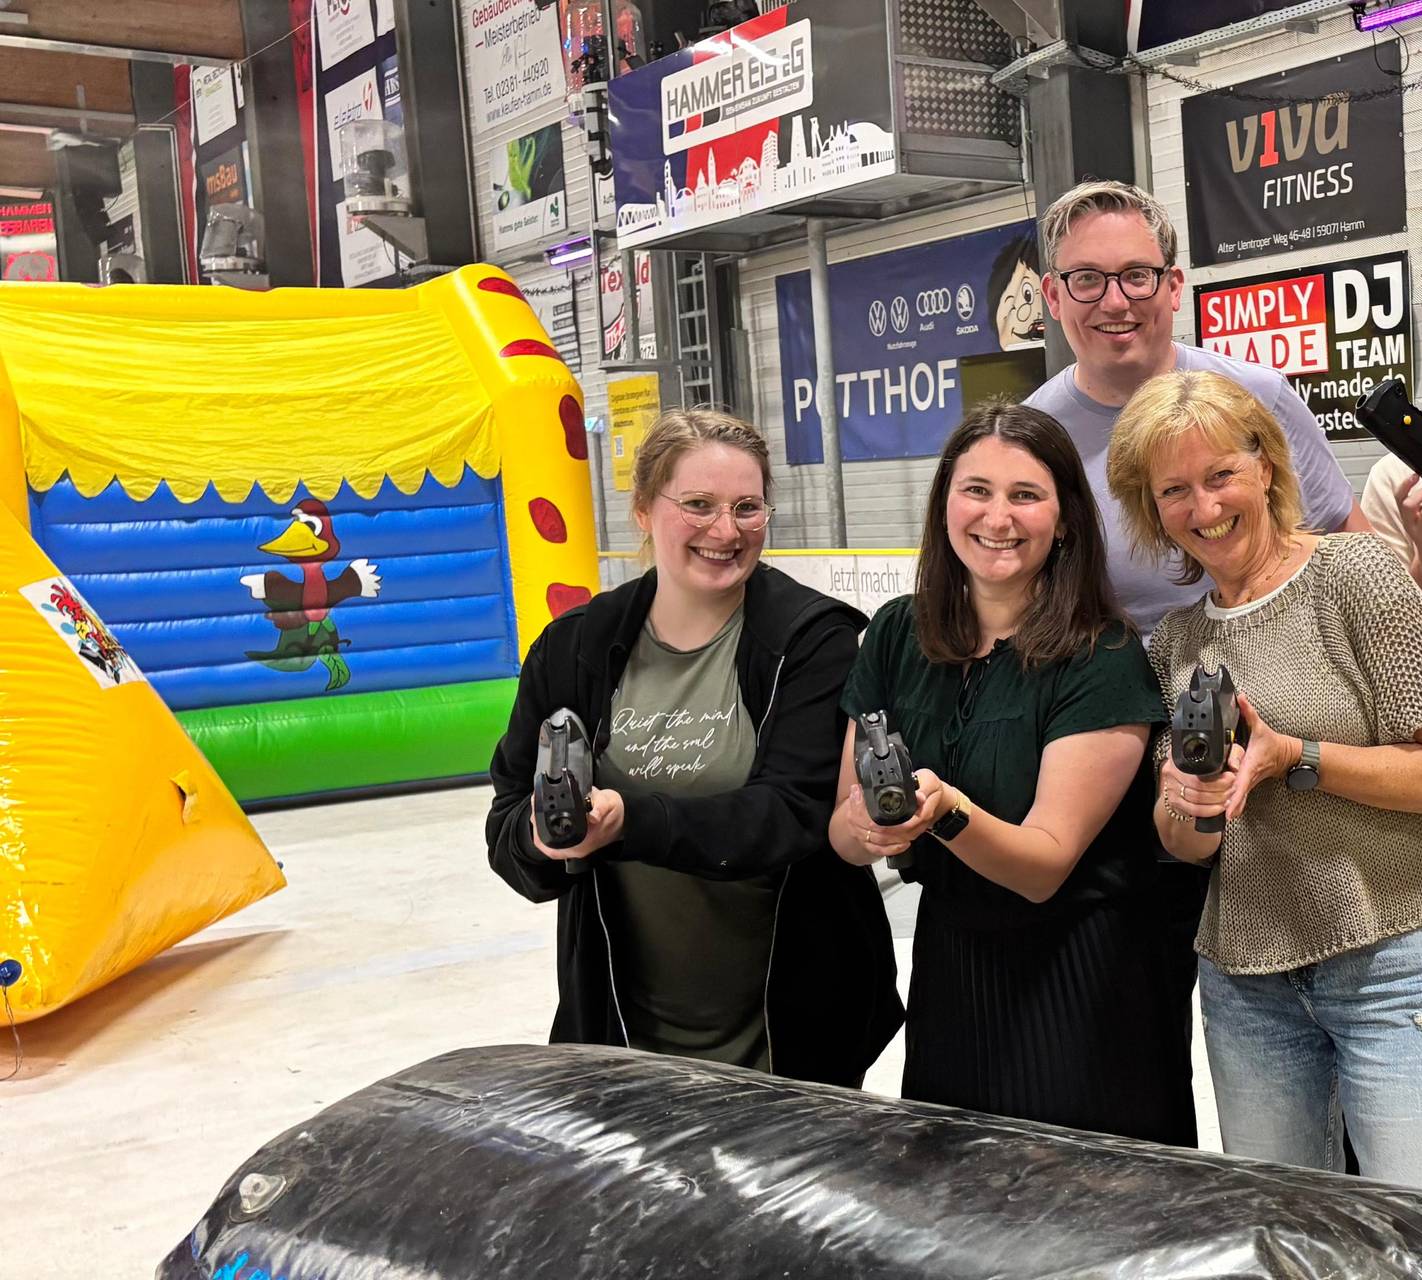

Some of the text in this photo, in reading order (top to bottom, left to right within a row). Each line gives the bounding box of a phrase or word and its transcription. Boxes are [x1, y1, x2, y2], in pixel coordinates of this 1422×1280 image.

[484, 7, 541, 48] Meisterbetrieb
[667, 61, 744, 120] HAMMER
[748, 48, 777, 90] EIS
[1263, 162, 1353, 209] FITNESS
[1218, 242, 1236, 253] Alter
[1273, 233, 1288, 246] Weg
[1289, 228, 1310, 241] 46-48
[1340, 220, 1365, 233] Hamm
[1207, 281, 1314, 334] SIMPLY
[1332, 260, 1404, 334] DJ
[1336, 334, 1406, 370] TEAM
[794, 358, 958, 422] PTTHOF
[830, 563, 901, 593] Jetzt macht
[611, 702, 737, 735] Quiet the mind
[624, 728, 715, 757] and the soul
[629, 754, 706, 779] will speak
